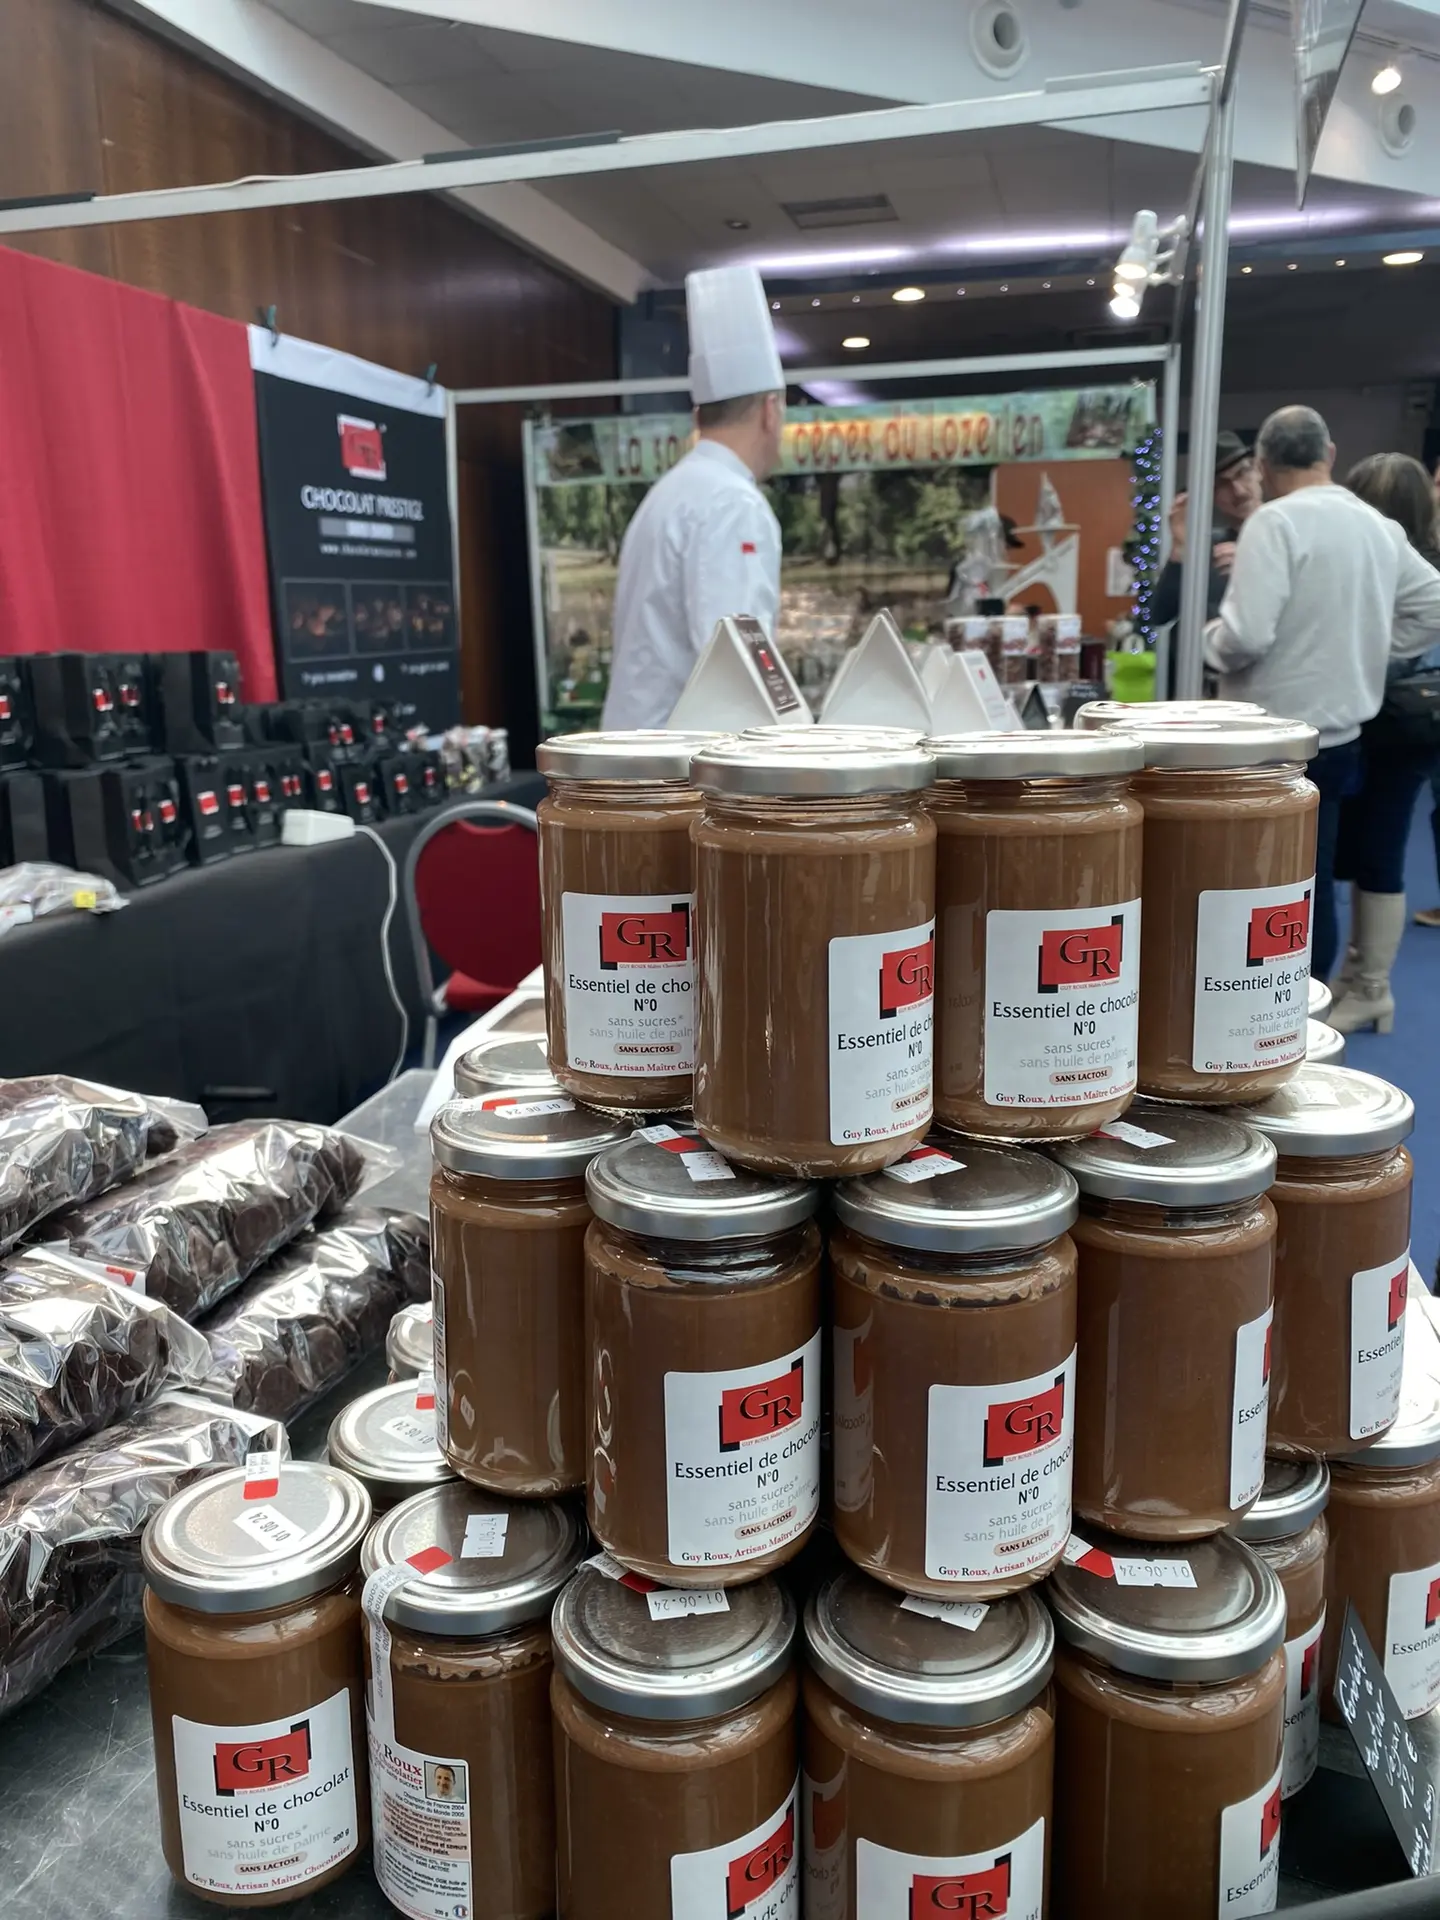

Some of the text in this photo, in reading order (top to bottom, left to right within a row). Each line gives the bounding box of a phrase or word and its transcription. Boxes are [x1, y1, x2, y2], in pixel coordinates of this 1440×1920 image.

[301, 485, 375, 513] CHOCOLAT
[617, 918, 680, 958] GR
[1265, 910, 1305, 948] GR
[1060, 934, 1116, 977] GR
[569, 974, 693, 993] Essentiel de cho
[897, 954, 933, 995] GR
[1204, 971, 1291, 991] Essentiel de
[634, 999, 657, 1011] N°0
[1275, 989, 1291, 1004] N°0
[993, 1002, 1070, 1018] Essentiel
[1076, 1001, 1095, 1016] de
[1250, 1012, 1274, 1023] sans
[608, 1017, 633, 1026] sans
[1073, 1021, 1096, 1035] N°0
[1228, 1027, 1255, 1037] sans
[1258, 1022, 1281, 1035] huile
[589, 1028, 665, 1039] sans huile de
[838, 1021, 922, 1050] Essentiel de
[908, 1040, 923, 1058] N°0
[1044, 1045, 1072, 1054] sans
[1259, 1040, 1276, 1048] SANS
[575, 1057, 587, 1068] Guy
[590, 1059, 612, 1070] Roux,
[614, 1063, 644, 1071] Artisan
[1019, 1052, 1101, 1068] sans huile de
[1205, 1057, 1279, 1071] Guy Roux, Artisan
[886, 1068, 908, 1082] sans
[1055, 1070, 1108, 1082] SANS LACTOSE
[865, 1086, 891, 1100] sans
[996, 1094, 1015, 1103] Guy
[1018, 1094, 1046, 1103] Roux,
[1048, 1092, 1081, 1103] Artisan
[895, 1099, 911, 1109] SANS
[843, 1129, 861, 1140] Guy
[864, 1126, 889, 1136] Roux,
[740, 1387, 797, 1427] GR
[1005, 1403, 1058, 1443] GR
[675, 1457, 753, 1479] Essentiel
[759, 1453, 778, 1468] de
[757, 1469, 779, 1488] N°0
[936, 1468, 1038, 1493] Essentiel de
[1018, 1486, 1039, 1505] N°0
[704, 1499, 785, 1527] sans huile de
[728, 1499, 756, 1511] sans
[741, 1512, 792, 1536] SANS LACTOSE
[964, 1516, 1043, 1542] sans huile de
[989, 1514, 1017, 1527] sans
[1000, 1531, 1050, 1553] SANS LACTOSE
[682, 1552, 702, 1563] Guy
[704, 1552, 732, 1562] Roux,
[734, 1543, 767, 1557] Artisan
[939, 1566, 959, 1578] Guy
[962, 1568, 990, 1577] Roux,
[992, 1560, 1025, 1574] Artisan
[1119, 1565, 1189, 1578] 01.06.24
[654, 1592, 723, 1611] 01.06.24
[233, 1746, 302, 1782] GR
[384, 1744, 422, 1776] Roux
[1401, 1732, 1418, 1808] 12 €
[183, 1766, 350, 1819] Essentiel de chocolat
[254, 1818, 279, 1833] N°0
[207, 1826, 332, 1860] sans huile de palme
[227, 1839, 254, 1849] sans
[332, 1828, 350, 1844] 300 g
[192, 1844, 350, 1891] Guy Roux, Artisan Maître Chocolatier
[239, 1855, 300, 1873] SANS LACTOSE
[932, 1880, 1000, 1920] GR
